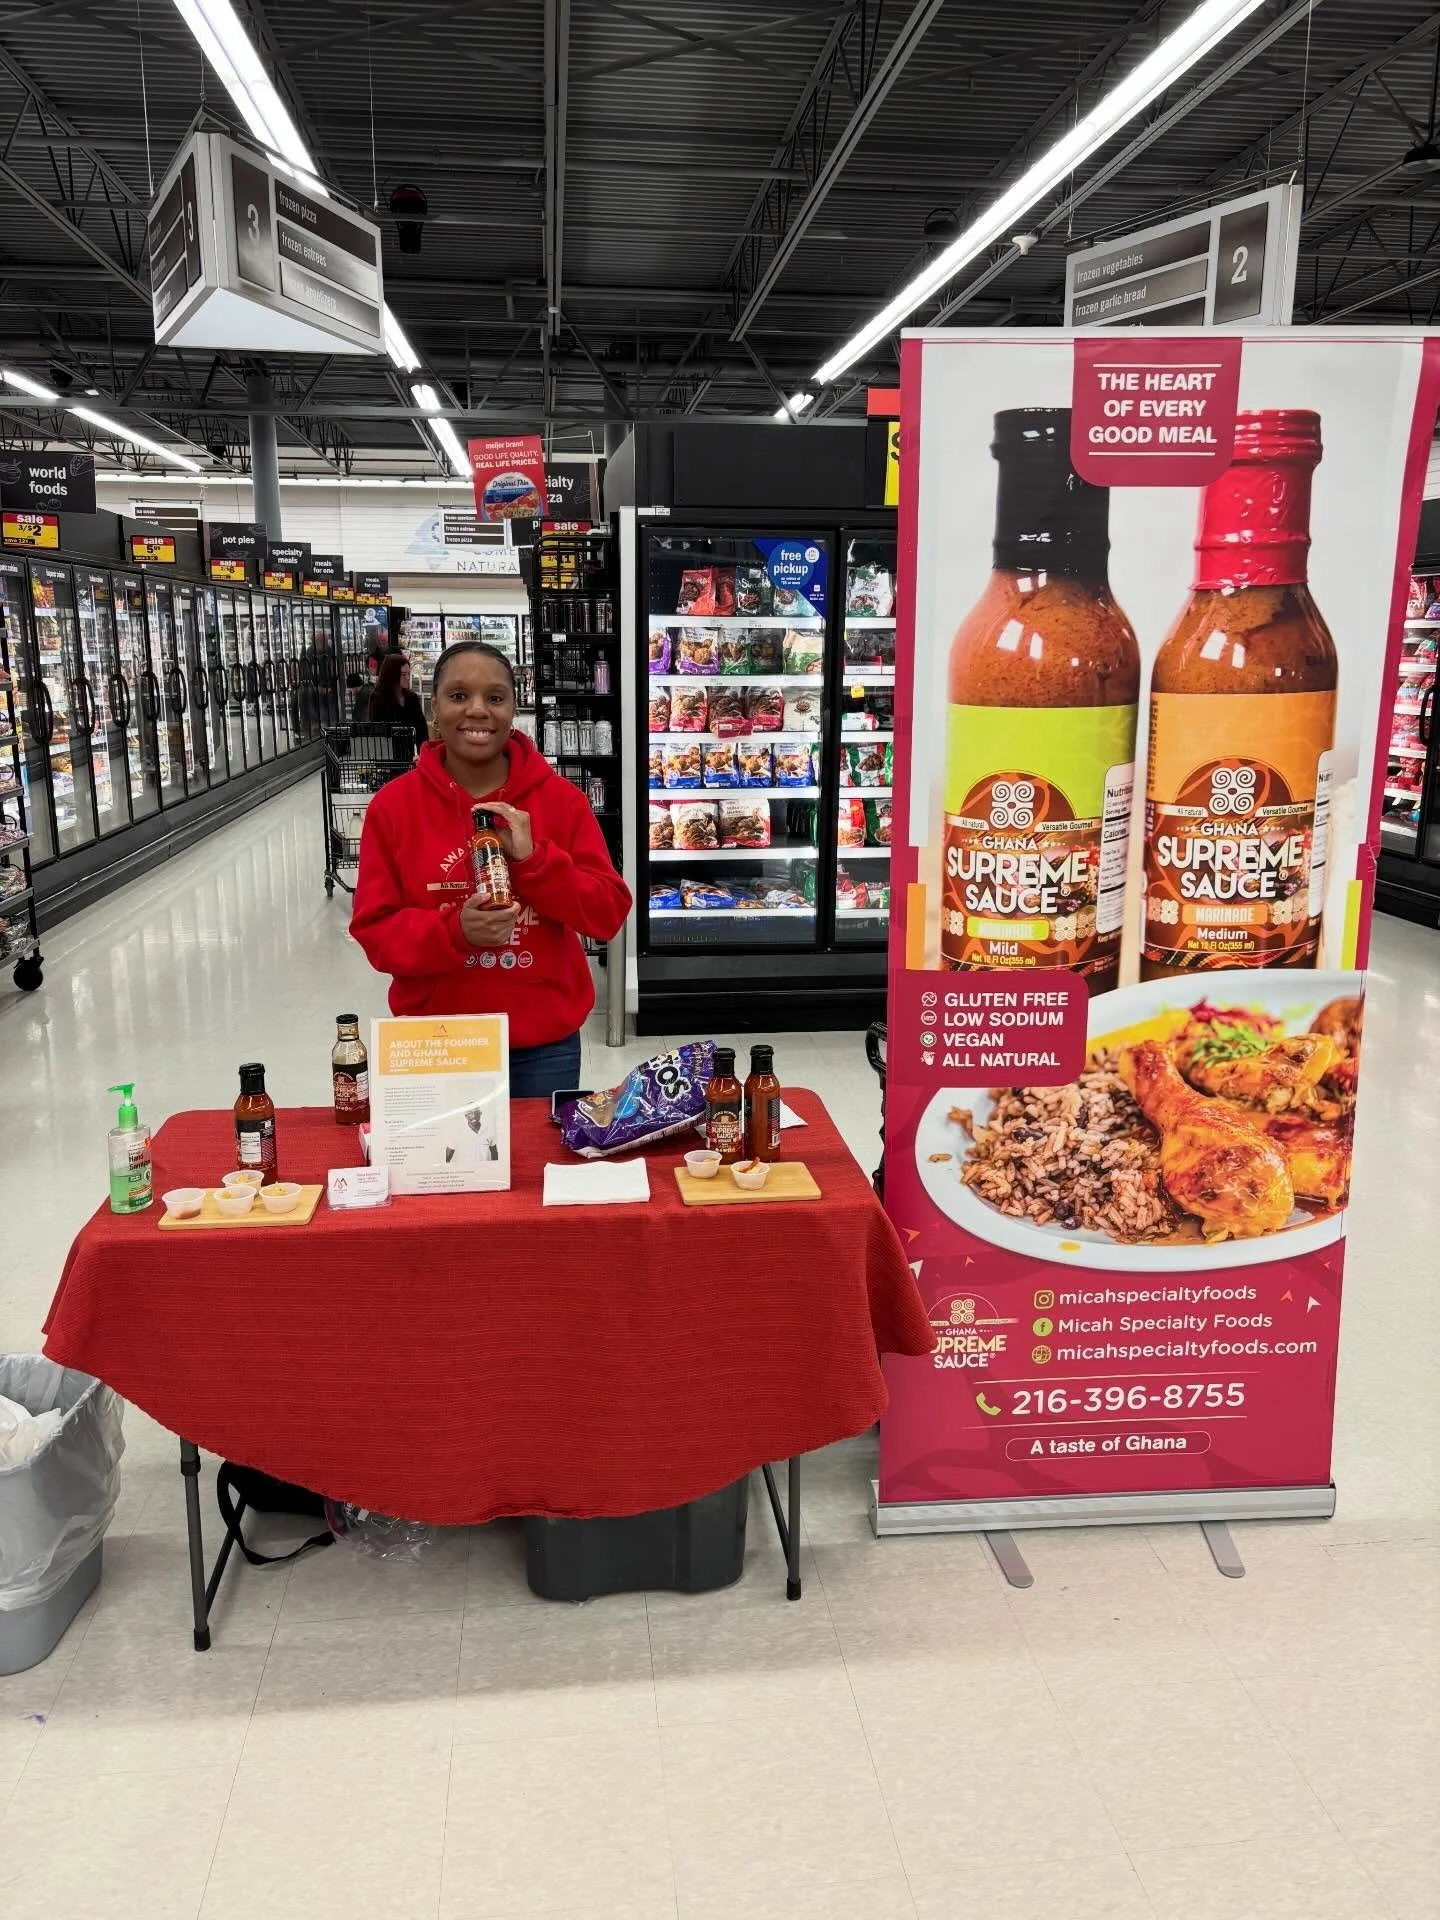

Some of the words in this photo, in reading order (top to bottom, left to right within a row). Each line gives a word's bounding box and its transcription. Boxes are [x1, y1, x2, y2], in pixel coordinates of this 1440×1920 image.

[280, 190, 300, 214] frozen
[301, 204, 317, 224] pizza
[187, 201, 194, 242] 3
[247, 204, 259, 247] 3
[281, 231, 303, 254] frozen
[1077, 268, 1101, 285] frozen
[1102, 254, 1143, 276] vegetables
[1231, 245, 1249, 285] 2
[1075, 302, 1099, 318] frozen
[1100, 294, 1122, 313] garlic
[1123, 285, 1147, 304] bread
[1098, 373, 1140, 391] THE
[1144, 373, 1217, 391] HEART
[1103, 400, 1135, 417] OF
[1139, 400, 1207, 417] EVERY
[1088, 426, 1153, 444] GOOD
[1158, 426, 1218, 444] MEAL
[473, 453, 494, 461] GOOD
[495, 452, 509, 460] LIFE
[29, 466, 67, 480] world
[28, 481, 68, 496] foods
[16, 514, 44, 524] sale
[553, 521, 579, 531] sale
[143, 537, 164, 545] sale
[222, 536, 236, 545] pot
[237, 536, 256, 545] pies
[271, 548, 303, 557] specialty
[780, 549, 802, 561] free
[773, 562, 809, 576] pickup
[1184, 808, 1203, 816] natural
[1262, 807, 1287, 816] Versatile
[968, 820, 984, 829] natural
[1042, 822, 1068, 831] Versatile
[1069, 820, 1093, 830] Gourmet
[1200, 822, 1259, 836] GHANA
[982, 836, 1038, 850] GHANA
[1157, 834, 1305, 870] SUPREME
[947, 846, 1091, 885] SUPREME
[1197, 927, 1248, 940] Medium
[989, 940, 1018, 956] Mild
[1187, 940, 1199, 949] Net
[944, 992, 1018, 1007] GLUTEN
[1023, 991, 1069, 1006] FREE
[944, 1012, 984, 1027] LOW
[989, 1011, 1064, 1026] SODIUM
[390, 1040, 421, 1049] ABOUT
[426, 1039, 443, 1048] THE
[444, 1037, 489, 1048] FOUNDER
[943, 1033, 1004, 1047] VEGAN
[390, 1049, 411, 1058] AND
[412, 1047, 449, 1057] GHANA
[942, 1053, 975, 1067] ALL
[980, 1052, 1061, 1067] NATURAL
[390, 1057, 433, 1068] SUPREME
[437, 1056, 469, 1066] SAUCE
[1059, 1285, 1257, 1306] micahspecialtyfoods
[1058, 1319, 1112, 1333] Micah
[1120, 1315, 1207, 1333] Specialty
[1213, 1312, 1273, 1329] Foods
[945, 1328, 978, 1336] GHANA
[1057, 1339, 1317, 1361] micahspecialtyfoods.com
[1011, 1383, 1246, 1415] 216-396-8755
[1030, 1440, 1044, 1455] A
[1050, 1438, 1096, 1455] taste
[1101, 1436, 1121, 1452] of
[1126, 1434, 1187, 1451] Ghana
